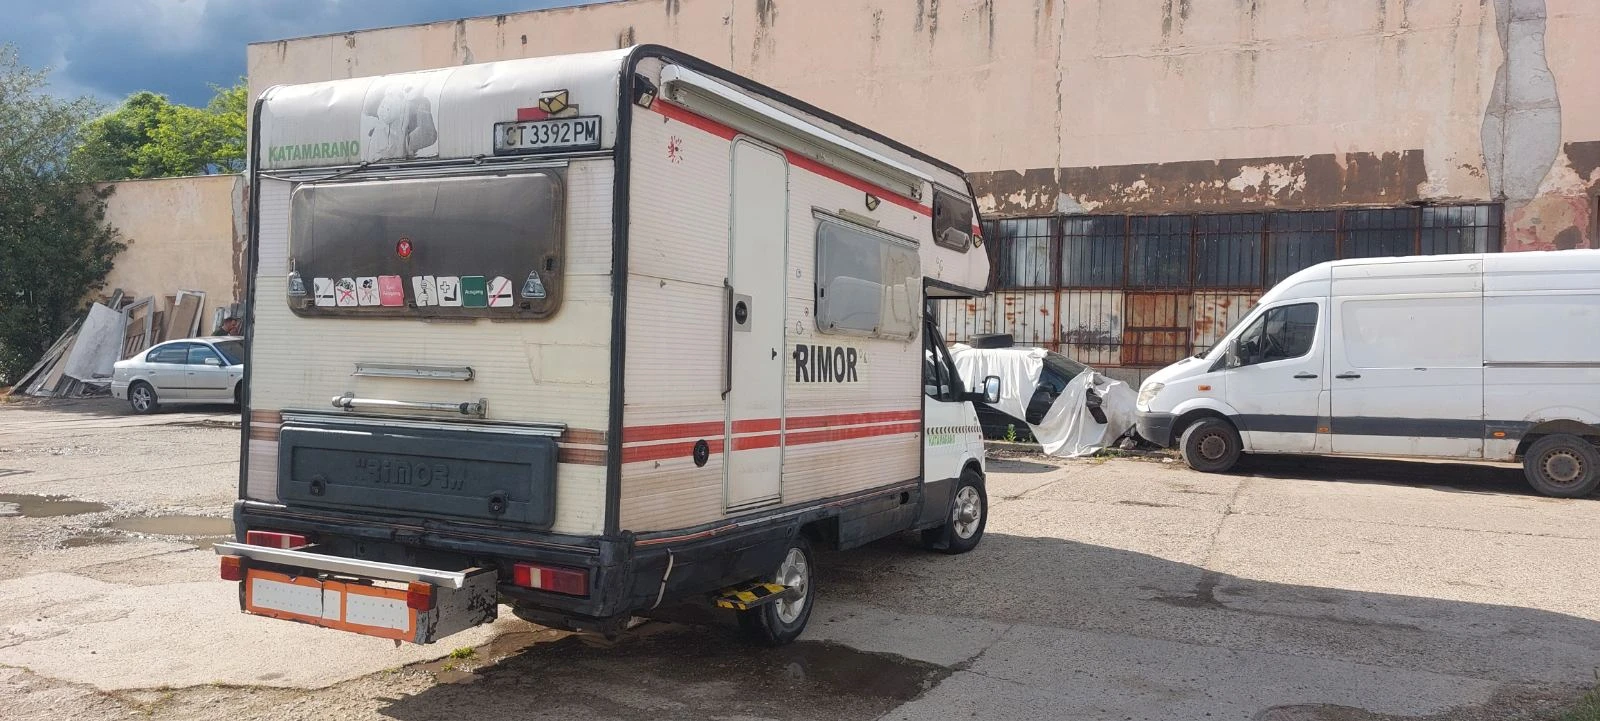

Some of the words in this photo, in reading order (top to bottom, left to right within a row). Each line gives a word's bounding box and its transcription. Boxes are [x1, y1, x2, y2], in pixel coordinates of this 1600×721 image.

[530, 123, 571, 145] 3392
[573, 120, 596, 142] PM
[268, 140, 360, 162] KATAMARANO
[796, 344, 858, 384] RIMOR
